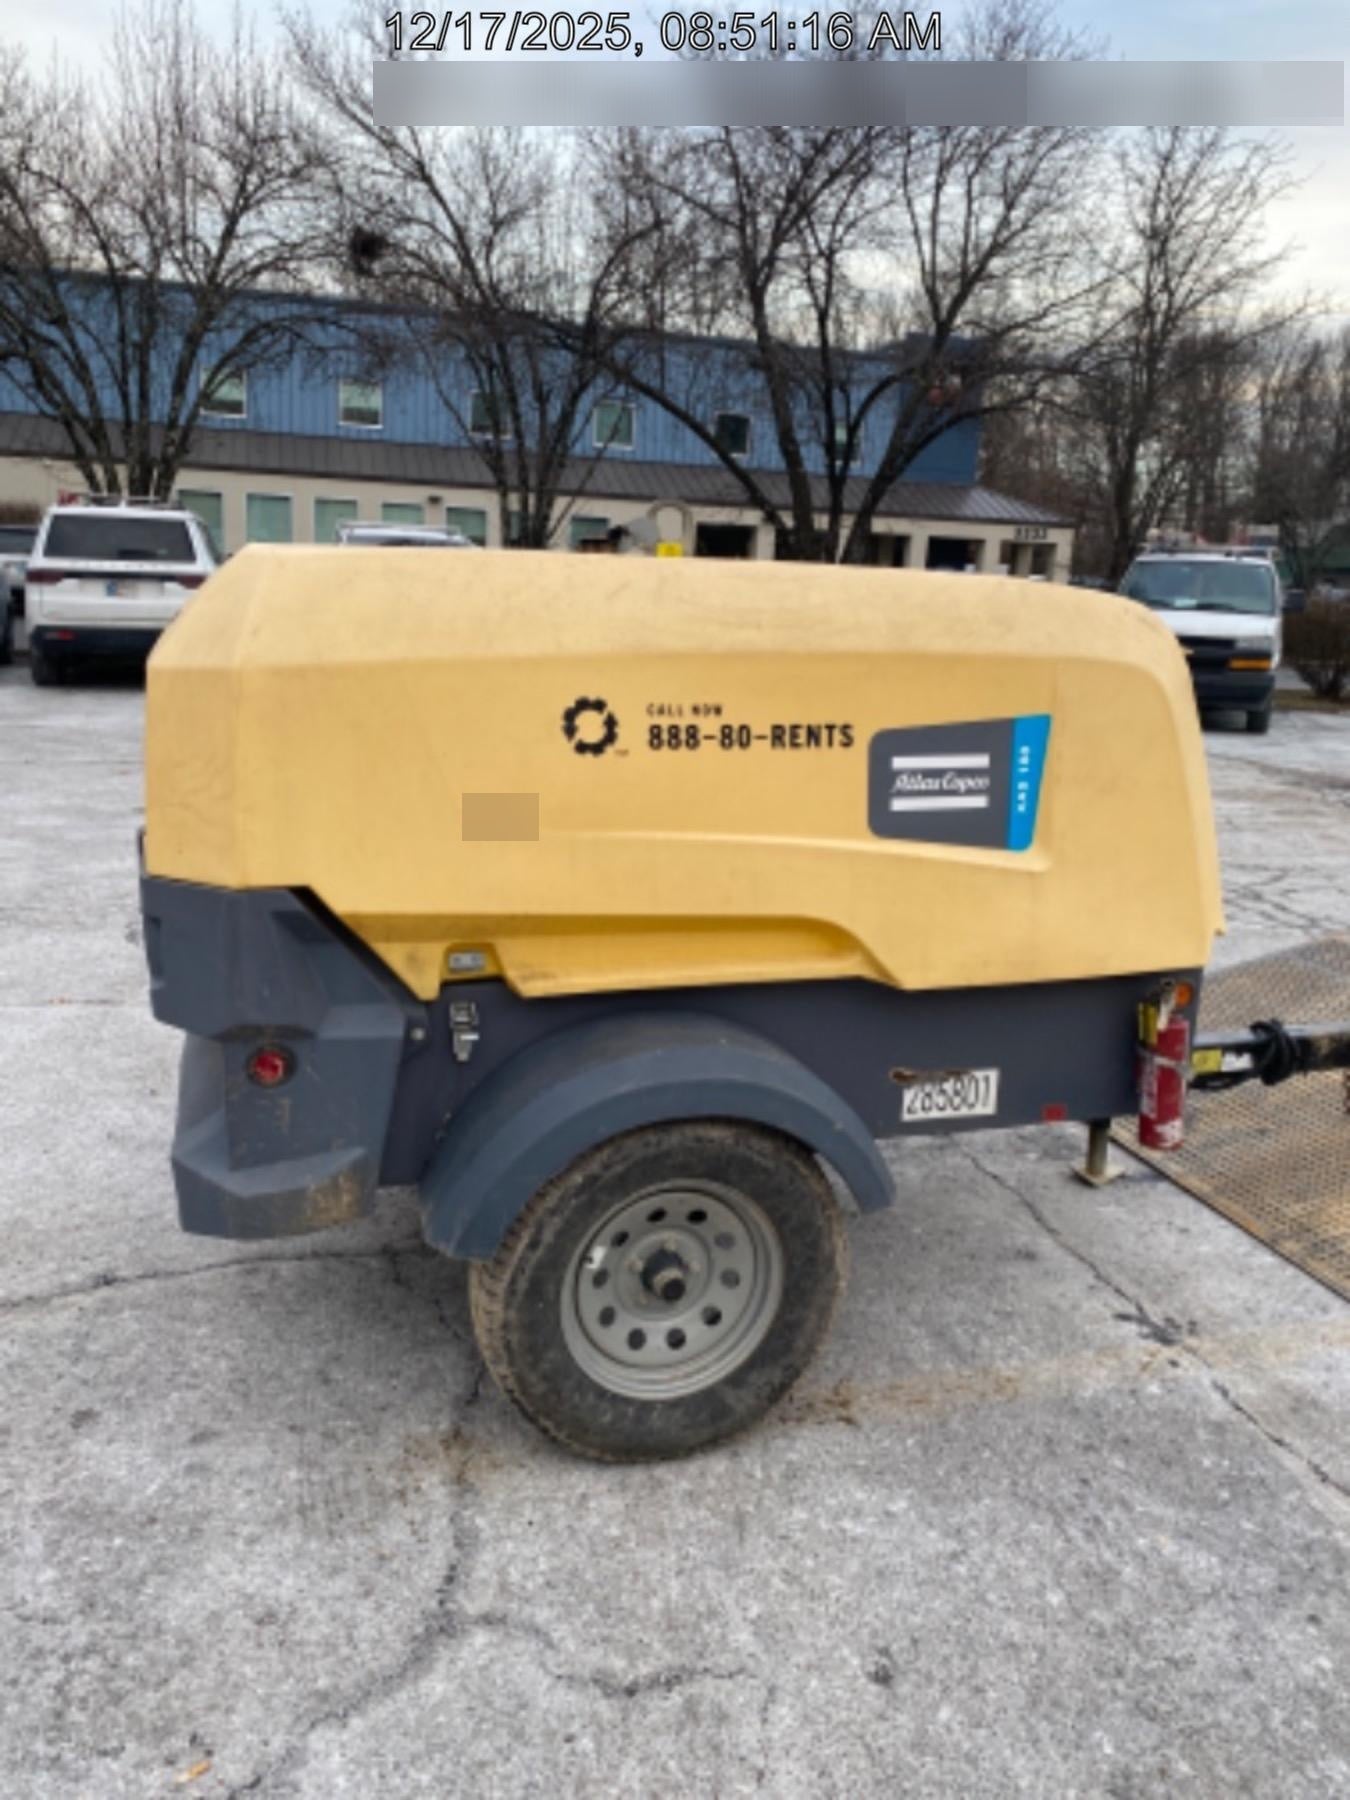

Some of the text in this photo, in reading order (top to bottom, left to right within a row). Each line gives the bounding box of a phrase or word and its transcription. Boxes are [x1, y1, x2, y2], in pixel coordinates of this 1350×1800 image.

[646, 702, 723, 717] CALL NOW
[648, 723, 855, 751] 888-80-RENTS
[892, 771, 991, 794] Atlas Copco
[906, 1072, 990, 1115] 285801
